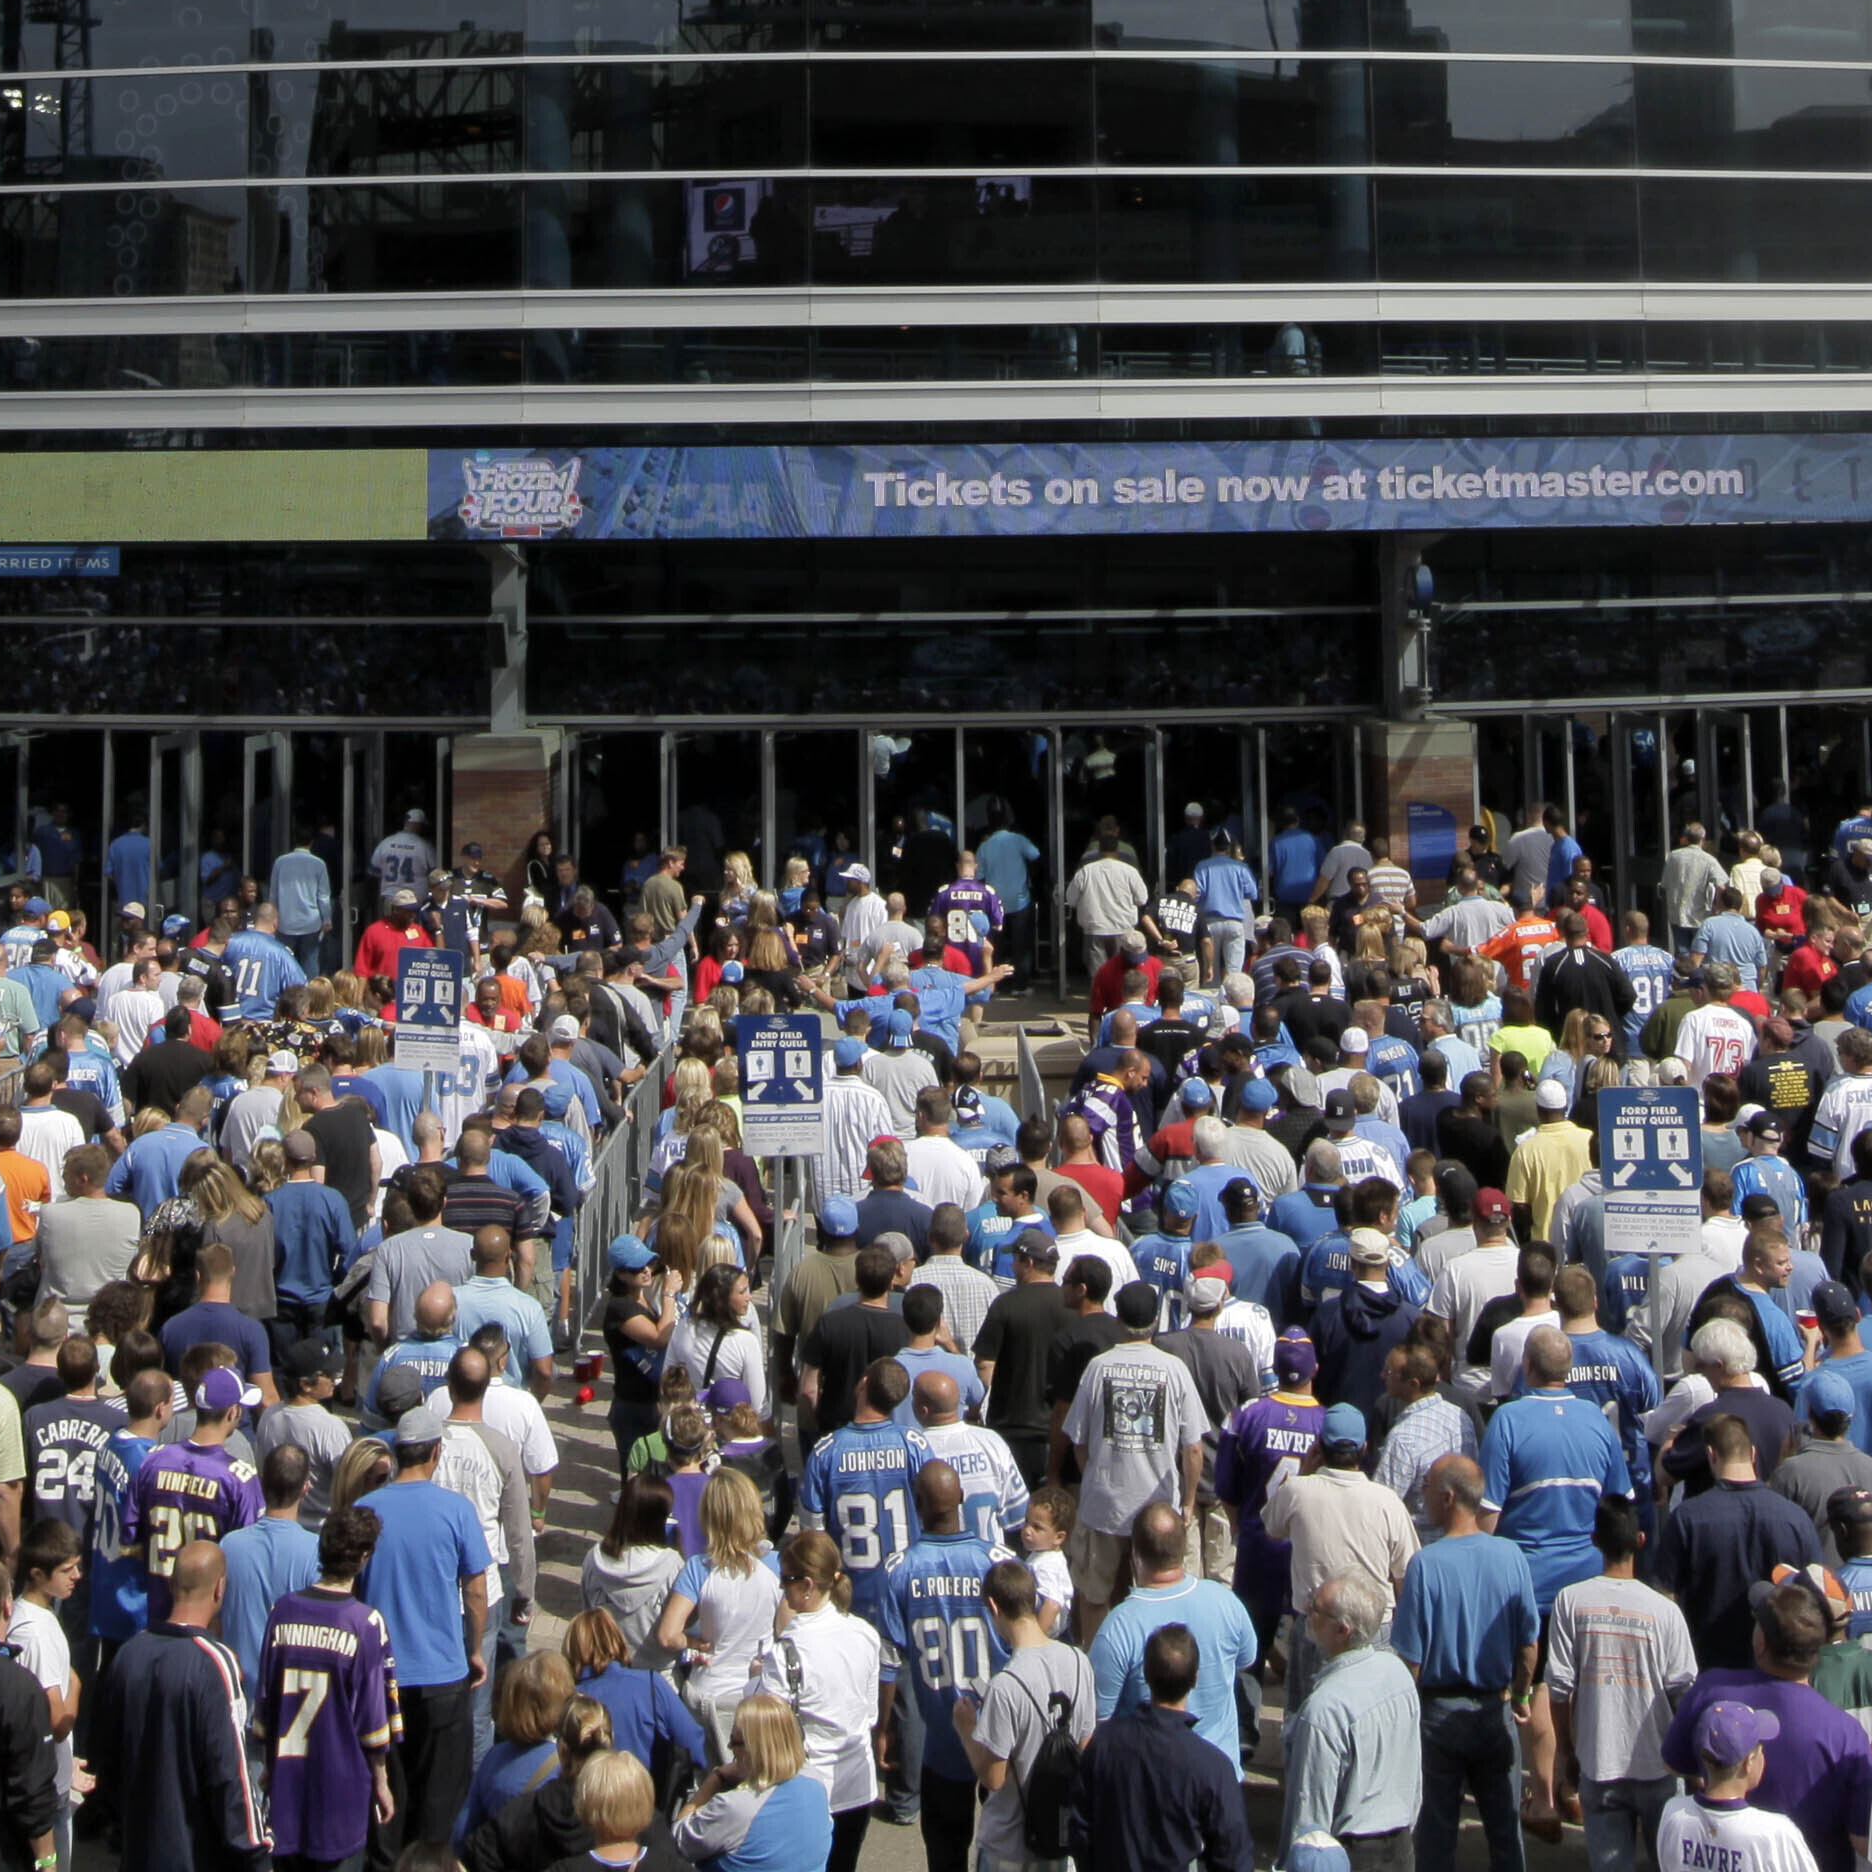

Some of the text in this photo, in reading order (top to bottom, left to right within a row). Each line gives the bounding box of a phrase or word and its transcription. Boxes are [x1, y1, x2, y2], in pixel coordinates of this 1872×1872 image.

[475, 468, 569, 492] FROZEN
[864, 463, 1745, 506] Tickets on sale now at ticketmaster.com
[482, 491, 565, 521] FOUR
[58, 558, 109, 569] ITEMS
[385, 855, 416, 884] 34
[237, 957, 261, 997] 11
[1632, 974, 1664, 1015] 81
[751, 1040, 808, 1048] ENTRY QUEUE
[1706, 1036, 1744, 1076] 73
[1616, 1116, 1683, 1126] ENTRY QUEUE
[1621, 1107, 1677, 1115] FORD FIELD
[1343, 1158, 1377, 1175] NSON
[982, 1216, 1013, 1234] SAND
[1153, 1255, 1177, 1277] SIMS
[1621, 1276, 1647, 1291] WILL
[1103, 1366, 1136, 1380] FINAL
[1137, 1369, 1166, 1383] FOUR
[1564, 1365, 1618, 1383] JOHNSON
[36, 1417, 110, 1448] CABRERA
[907, 1430, 927, 1451] 8
[838, 1449, 906, 1474] JOHNSON
[36, 1448, 97, 1501] 24
[156, 1470, 218, 1501] WINFIELD
[836, 1487, 910, 1569] 81
[912, 1578, 981, 1600] C.ROGERS
[912, 1615, 993, 1691] 80
[277, 1668, 329, 1758] 7
[1682, 1838, 1743, 1872] FAVRE
